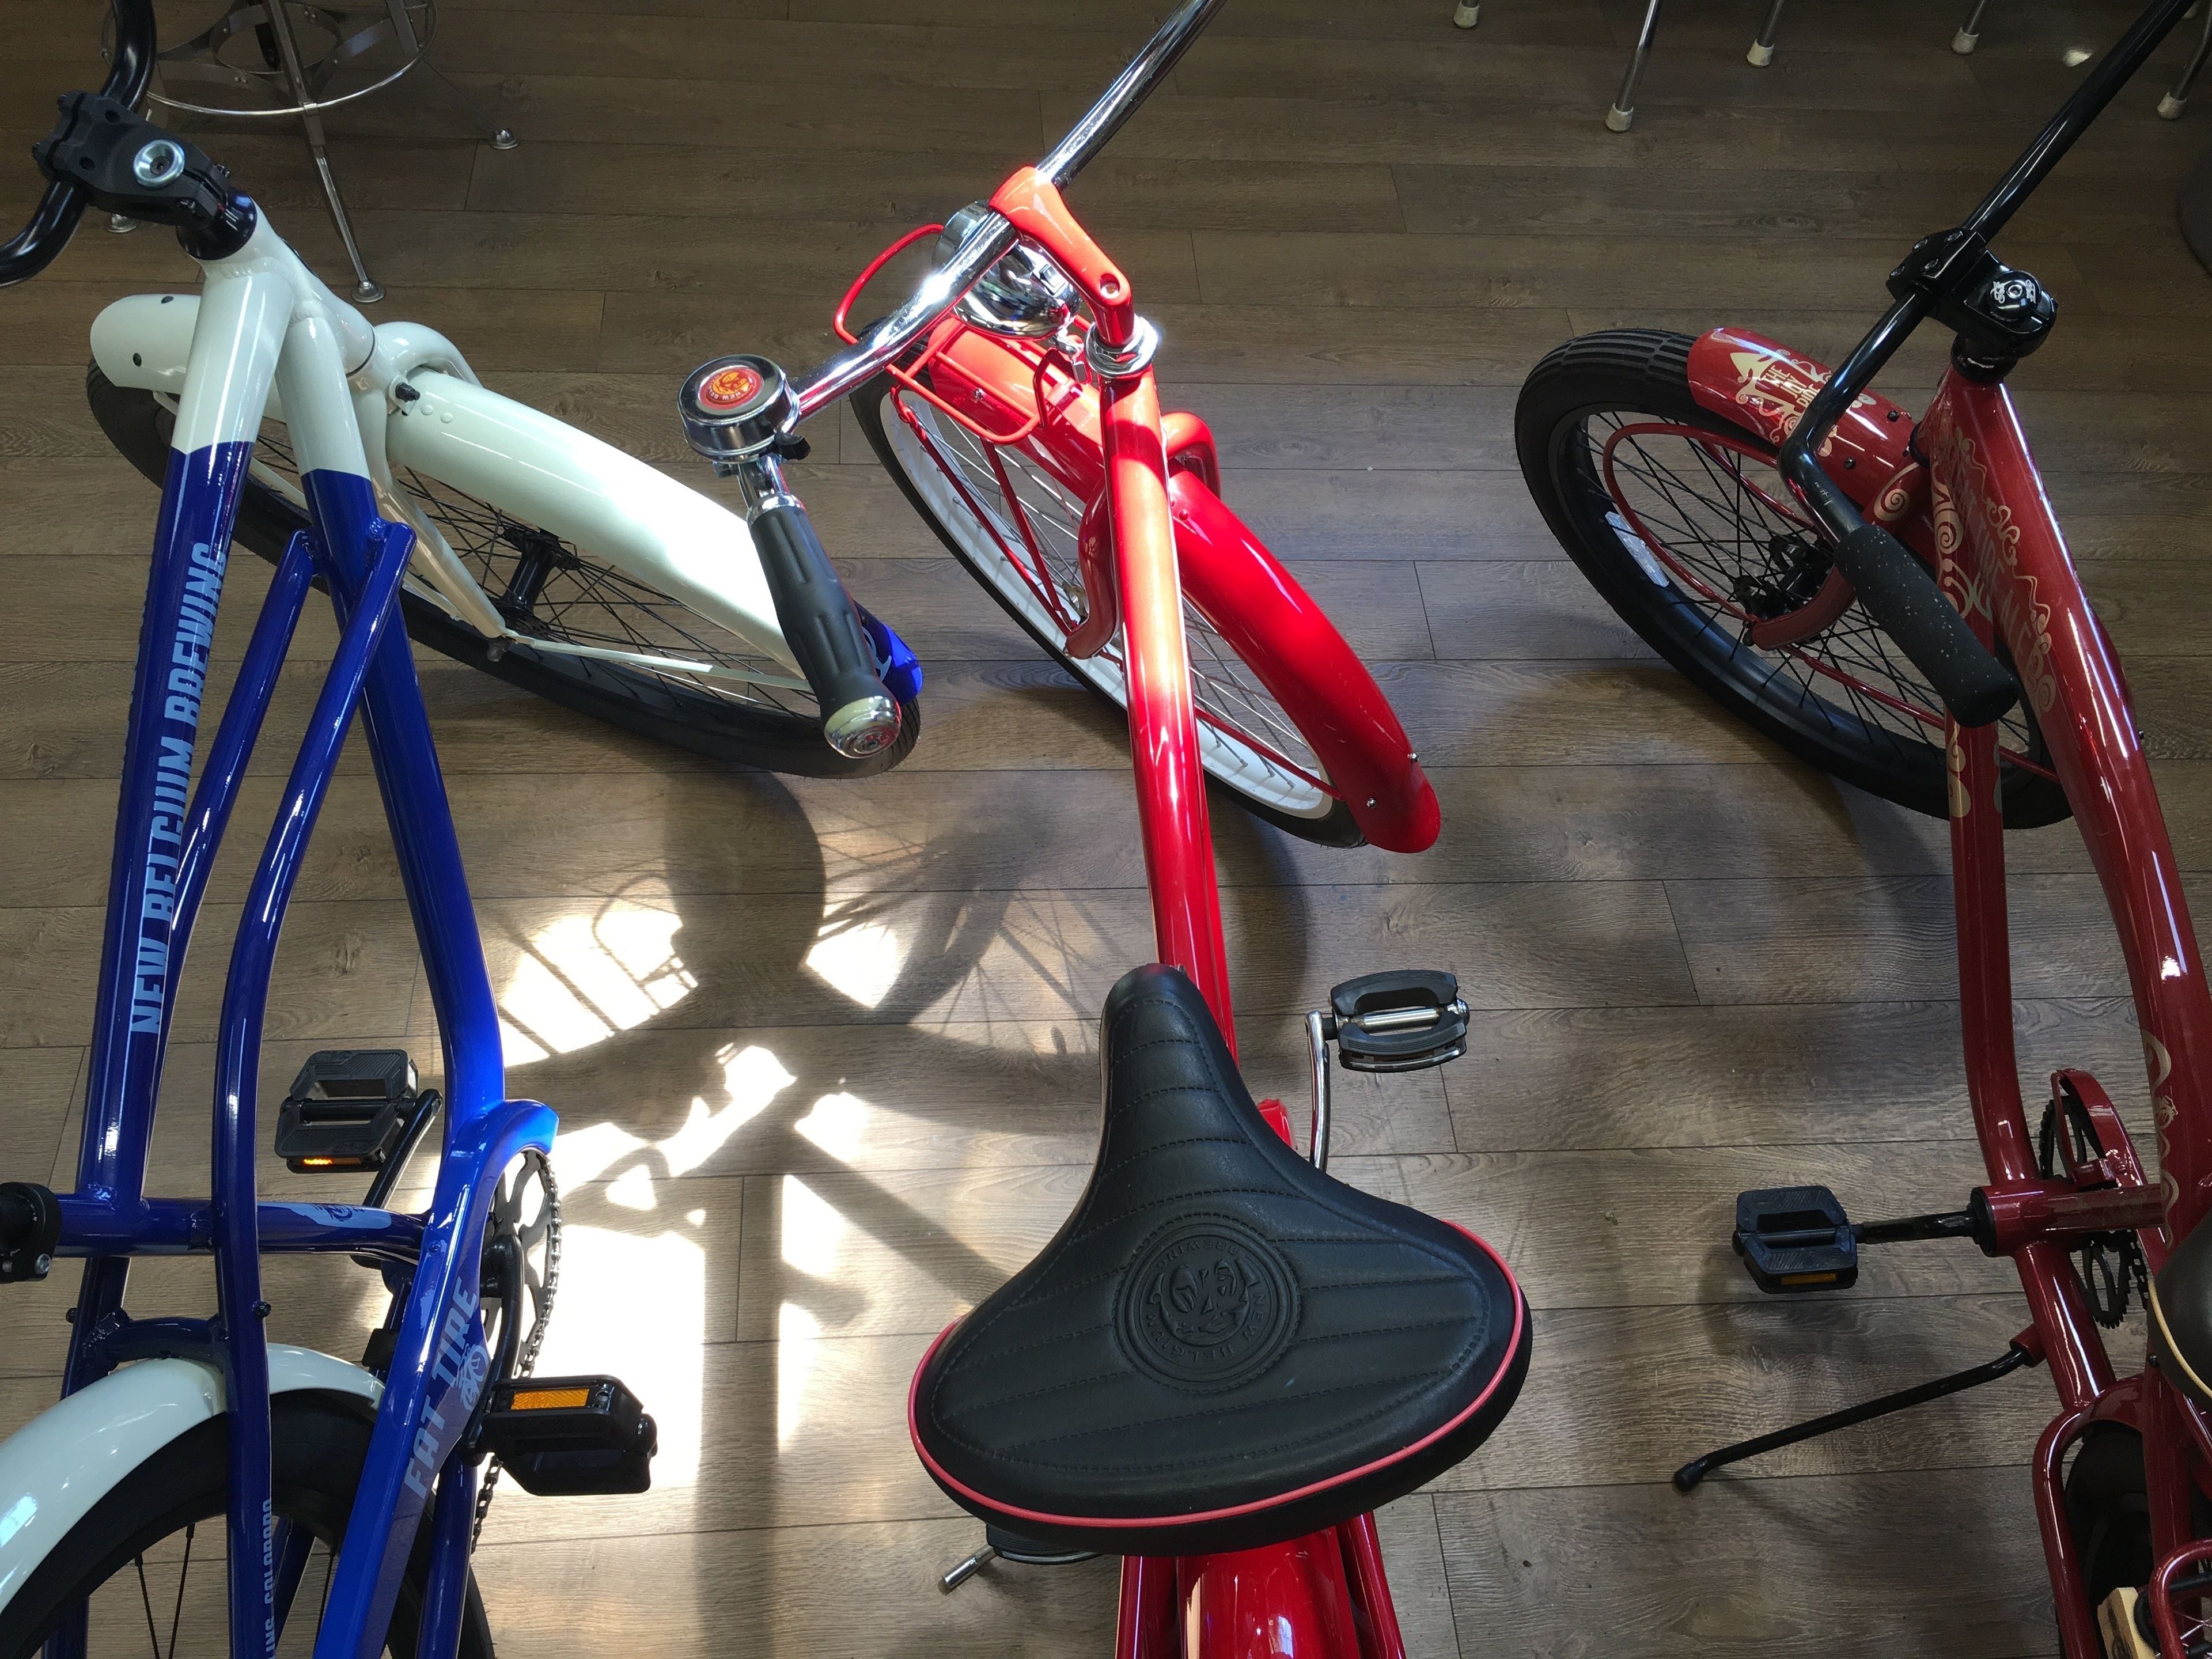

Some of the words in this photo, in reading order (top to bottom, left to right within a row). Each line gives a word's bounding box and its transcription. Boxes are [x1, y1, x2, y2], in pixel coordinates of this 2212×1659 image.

[165, 542, 228, 726] BREWING
[142, 737, 193, 922] BELGIUM
[130, 937, 168, 1035] NEW
[1156, 1238, 1239, 1269] BREWING
[1242, 1293, 1266, 1342] NEW
[404, 1395, 446, 1499] FAT
[431, 1277, 478, 1388] TIRE
